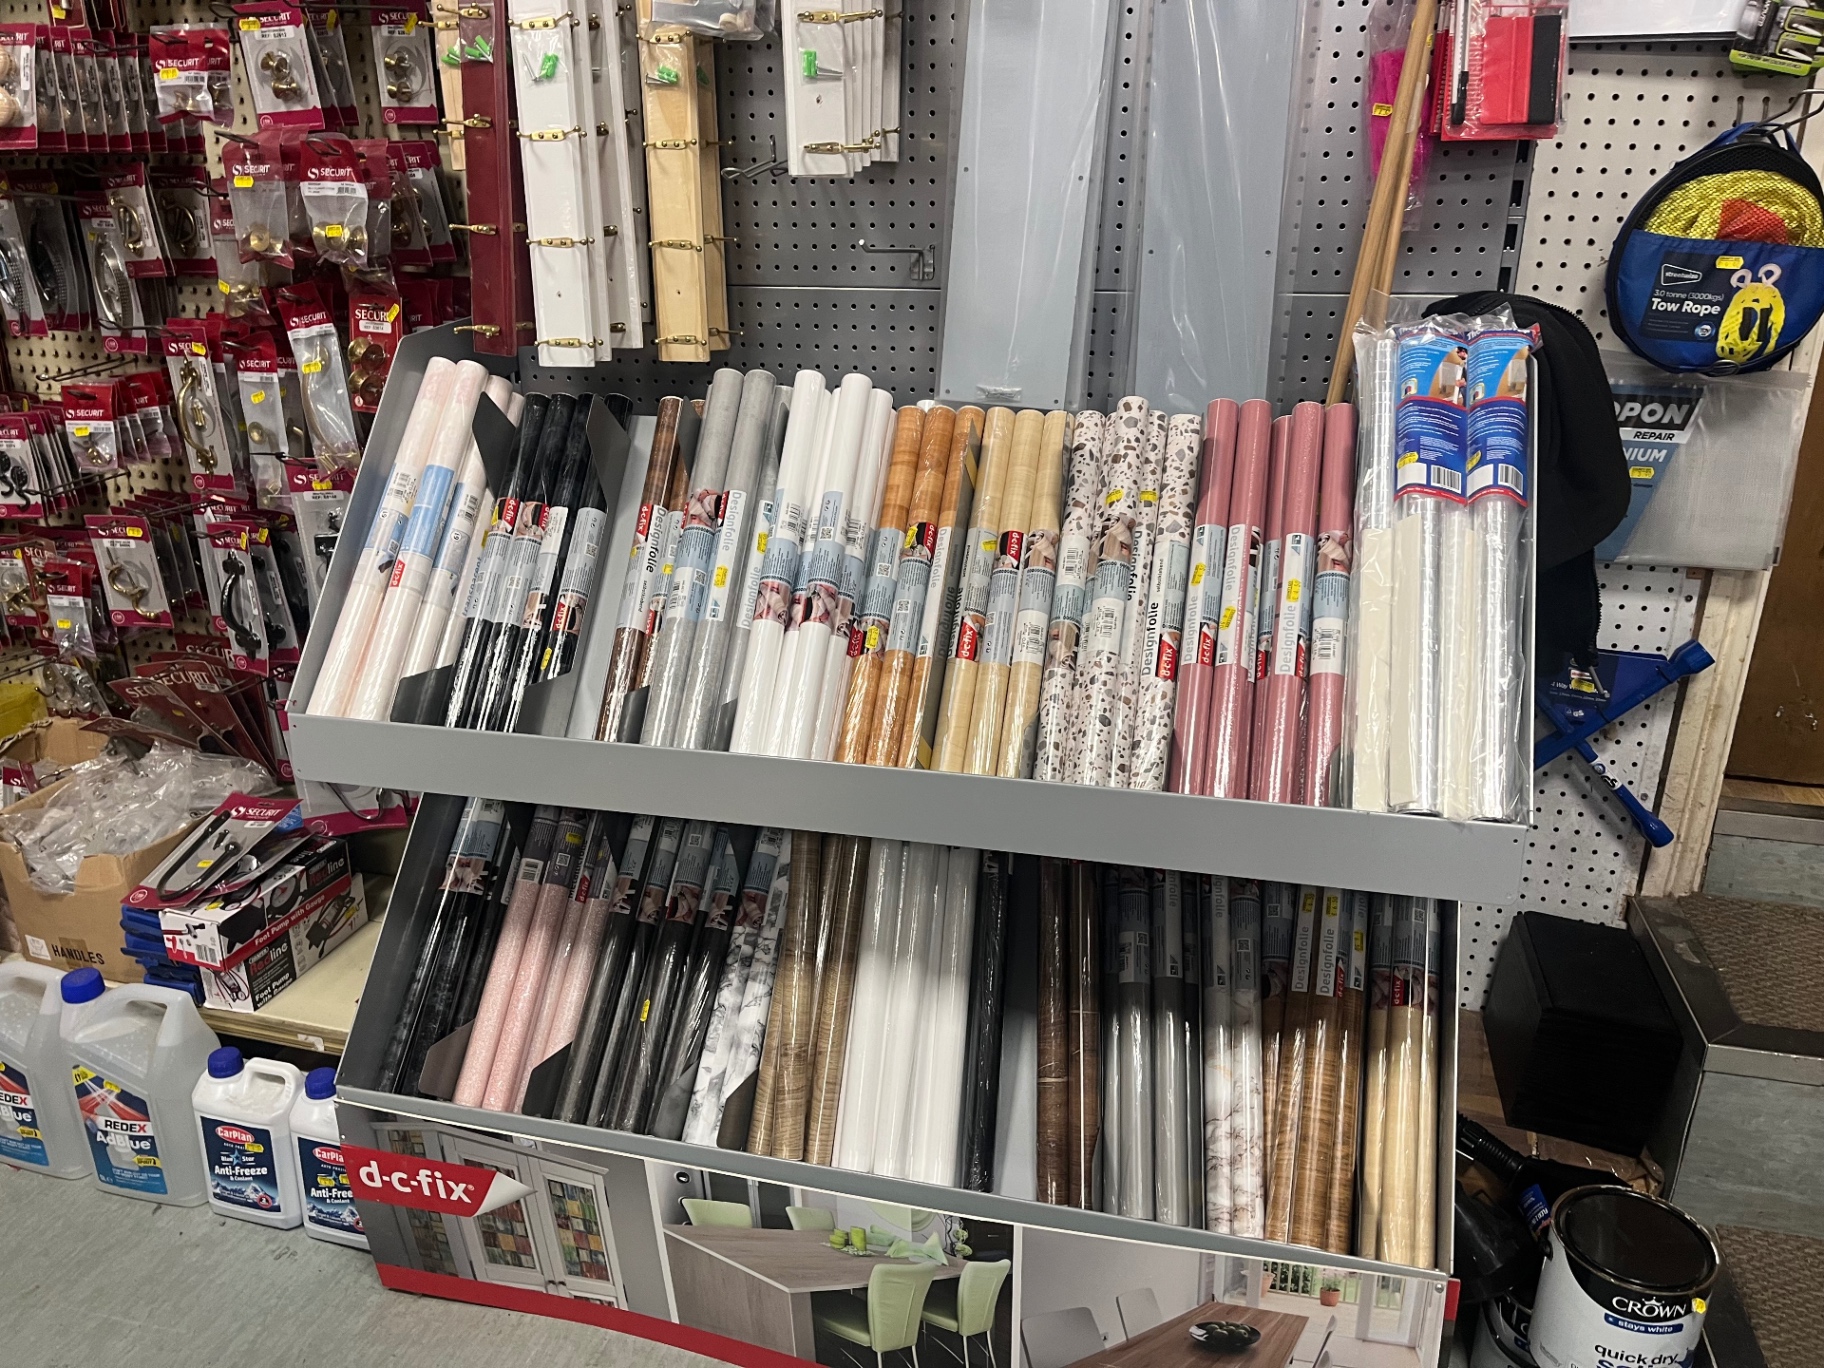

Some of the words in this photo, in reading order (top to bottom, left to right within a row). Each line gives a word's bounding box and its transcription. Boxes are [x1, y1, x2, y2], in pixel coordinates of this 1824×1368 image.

[167, 57, 200, 67] SECURIT
[320, 168, 352, 178] SECURIT
[300, 311, 327, 324] SECURIT
[1651, 297, 1680, 311] Tow
[1681, 300, 1721, 317] Rope
[76, 409, 104, 417] SECURIT
[1632, 430, 1676, 442] REPAIR
[721, 491, 743, 552] Designfolie
[646, 507, 667, 574] Designfolie
[1009, 532, 1020, 556] d-c-fix
[931, 527, 948, 589] Designfolie
[1224, 526, 1241, 592] Designfolie
[461, 556, 482, 617] transparent
[741, 566, 762, 628] Designfolie
[1141, 601, 1159, 677] Designfolie
[1183, 594, 1199, 663] Designfolie
[1279, 604, 1297, 674] Designfolie
[961, 628, 974, 658] d-c-fix
[1201, 636, 1212, 664] d-c-fix
[245, 808, 282, 817] SECURIT
[254, 931, 271, 947] Foot
[271, 919, 290, 935] Pump
[290, 908, 305, 921] with
[305, 894, 325, 910] Gauge
[51, 943, 105, 966] HANDLES
[1294, 926, 1310, 990] Designfolie
[1319, 928, 1335, 994] Designfolie
[255, 986, 272, 1002] Foot
[272, 972, 290, 989] Pump
[104, 1119, 147, 1133] REDEX
[216, 1127, 253, 1142] CarPlan
[96, 1131, 151, 1150] AdBlue
[315, 1148, 344, 1163] CarPla
[214, 1165, 268, 1176] Anti-Freeze
[358, 1160, 472, 1204] d-c-fix
[310, 1187, 353, 1198] Anti-Free
[1611, 1296, 1687, 1318] CROWN
[1618, 1319, 1646, 1332] stays
[1647, 1324, 1673, 1333] white
[1594, 1343, 1648, 1365] quick
[1651, 1352, 1679, 1366] dry
